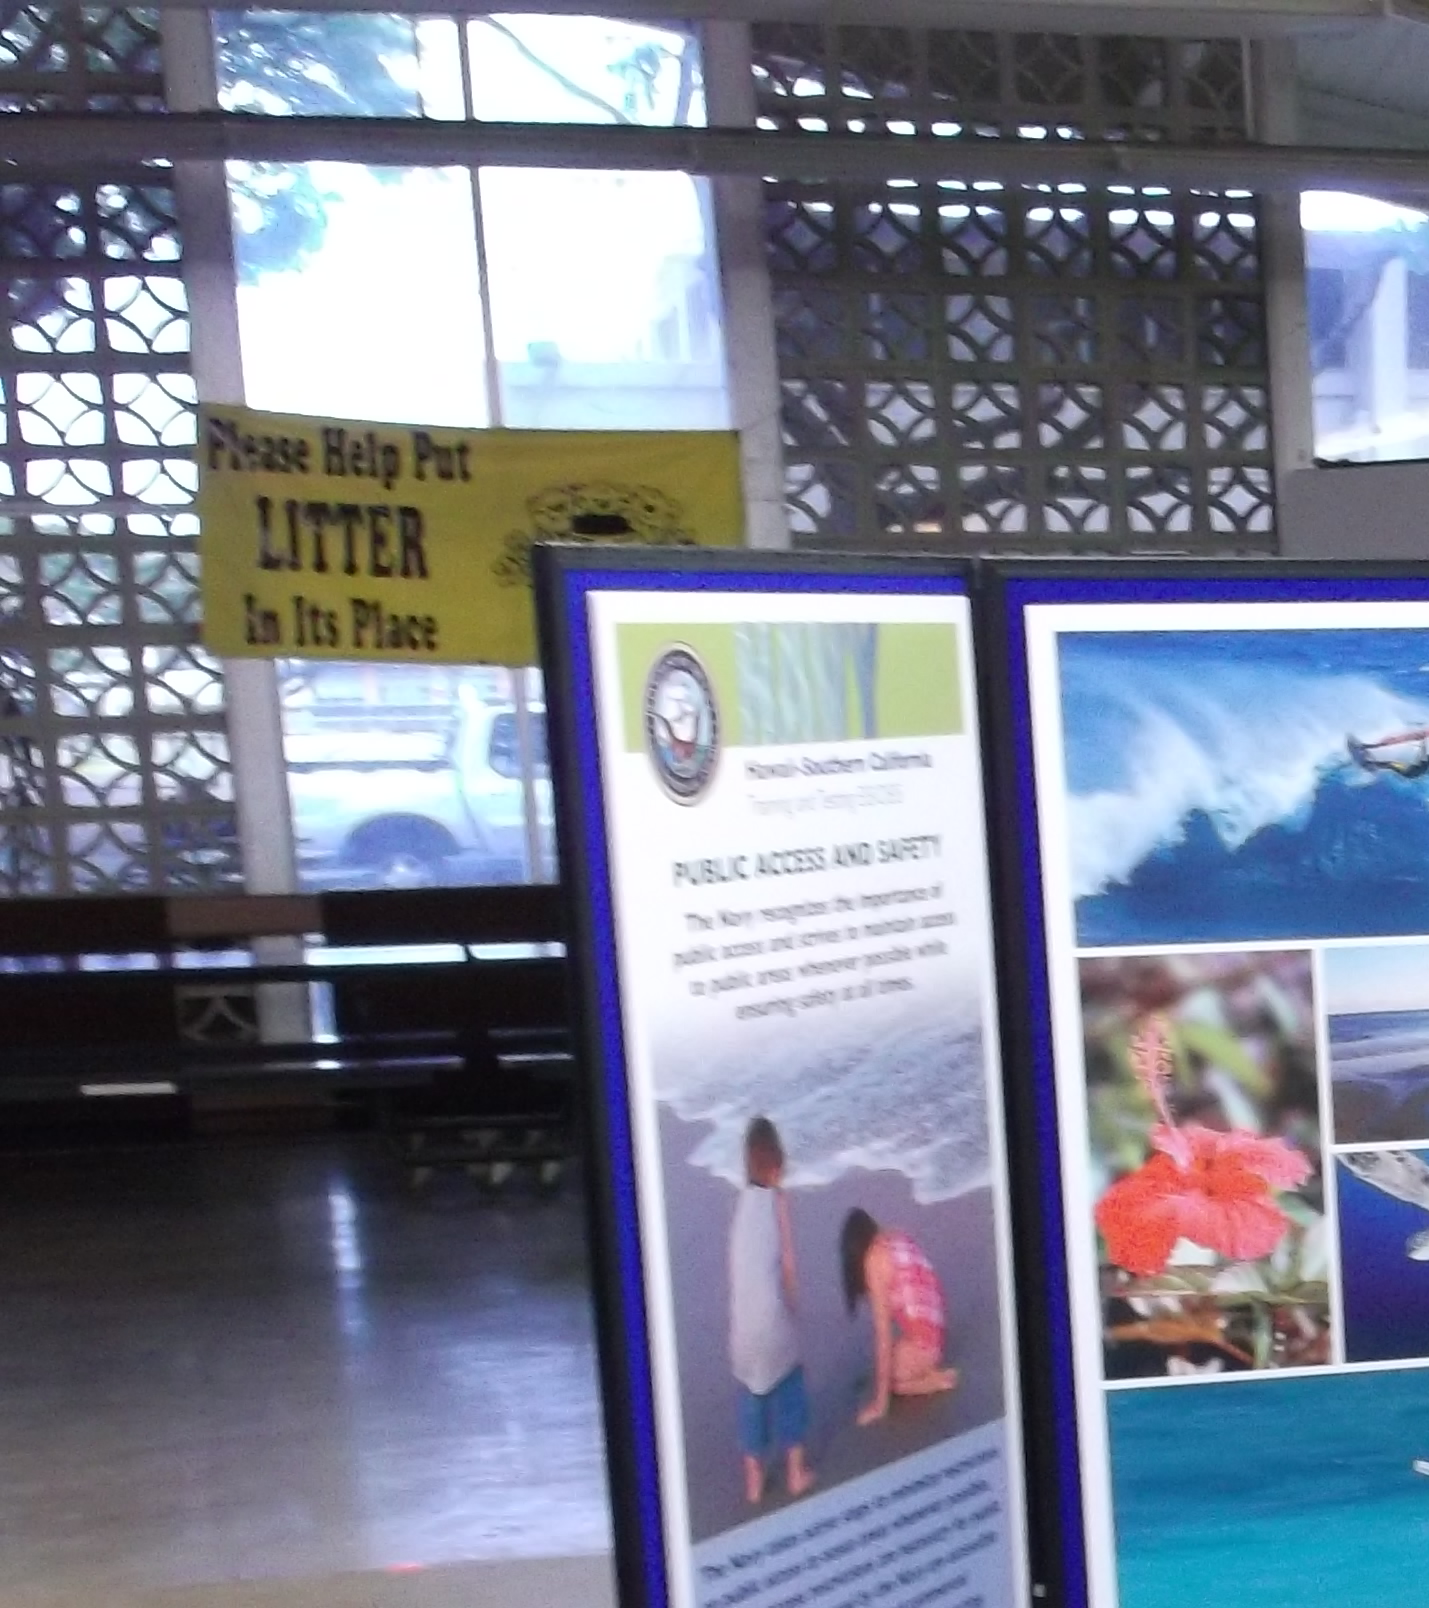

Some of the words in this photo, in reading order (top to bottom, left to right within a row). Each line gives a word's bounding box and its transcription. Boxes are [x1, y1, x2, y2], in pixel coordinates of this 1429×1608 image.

[207, 417, 311, 473] Please
[322, 427, 401, 491] Help
[411, 431, 473, 482] Put
[256, 495, 430, 579] LITTER
[244, 592, 282, 645] In
[293, 595, 340, 648] Its
[348, 597, 439, 651] Place
[673, 855, 750, 887] PUBLIC
[755, 846, 826, 877] ACCESS
[833, 841, 876, 868] AND
[876, 834, 942, 865] SAFETY
